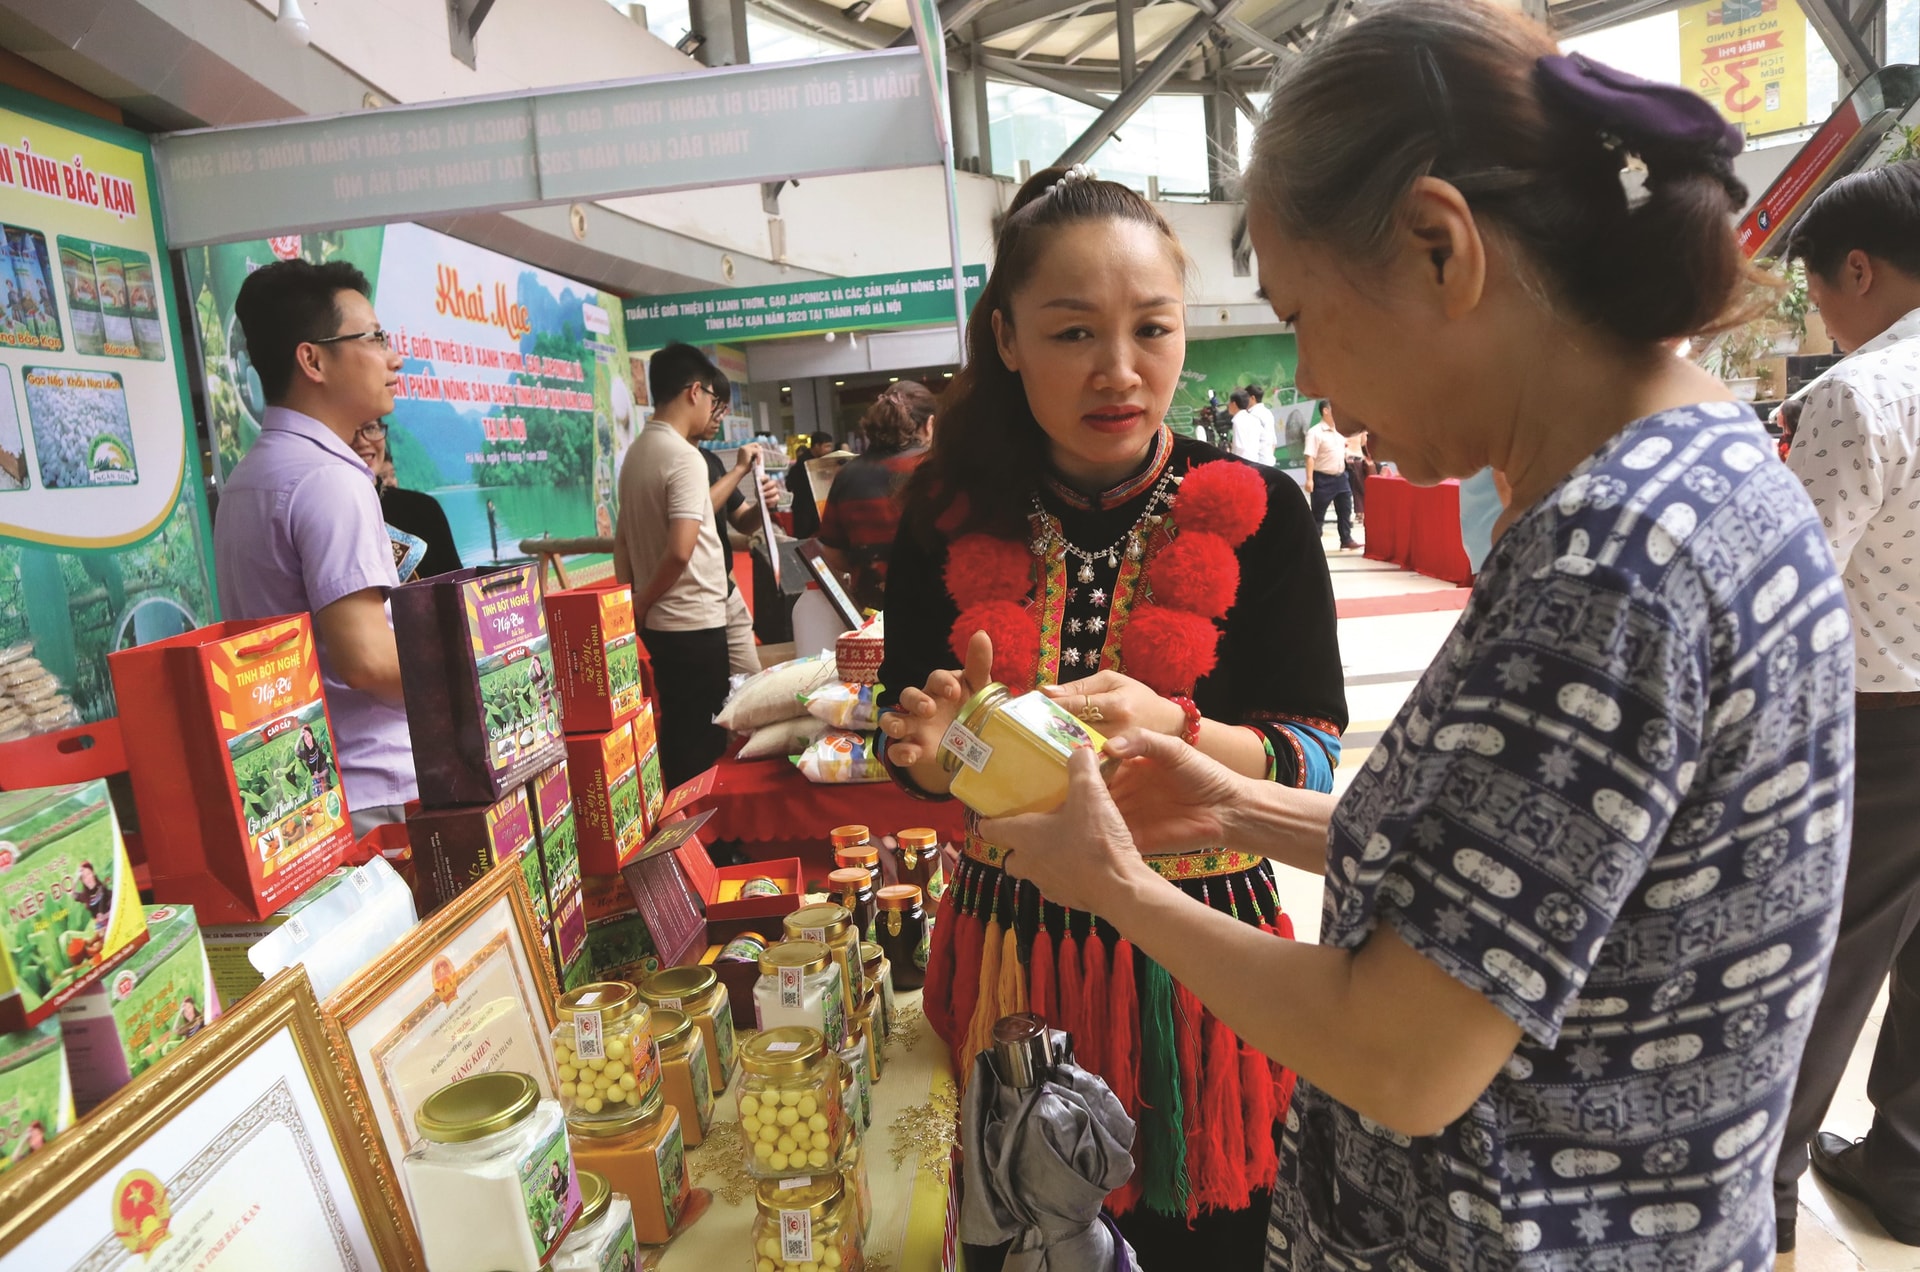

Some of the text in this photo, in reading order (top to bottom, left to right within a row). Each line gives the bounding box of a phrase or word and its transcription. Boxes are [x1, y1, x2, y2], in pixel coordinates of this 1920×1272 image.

[17, 141, 61, 198] TỈNH
[63, 156, 99, 207] BẮC
[102, 176, 137, 222] KẠN
[434, 262, 532, 343] Khai Mạc
[679, 299, 703, 317] THIỆU
[715, 298, 740, 314] XANH
[787, 290, 831, 307] JAPONICA
[831, 287, 844, 303] VÀ
[844, 283, 863, 301] CÁC
[909, 275, 935, 294] NÔNG
[764, 309, 786, 326] NĂM
[786, 307, 808, 324] 2020
[808, 307, 823, 325] TẠI
[823, 303, 852, 320] THÀNH
[852, 299, 872, 318] PHỐ
[872, 299, 885, 316] HÀ
[475, 346, 500, 368] XANH
[409, 365, 441, 399] PHẨM
[442, 378, 470, 402] NÔNG
[496, 597, 510, 617] BỘT
[509, 592, 531, 609] NGHỆ
[235, 648, 301, 688] TINH BỘT NGHỆ
[590, 623, 608, 698] TINH BỘT NGHỆ
[266, 724, 280, 738] CAO
[471, 1038, 493, 1065] KHEN
